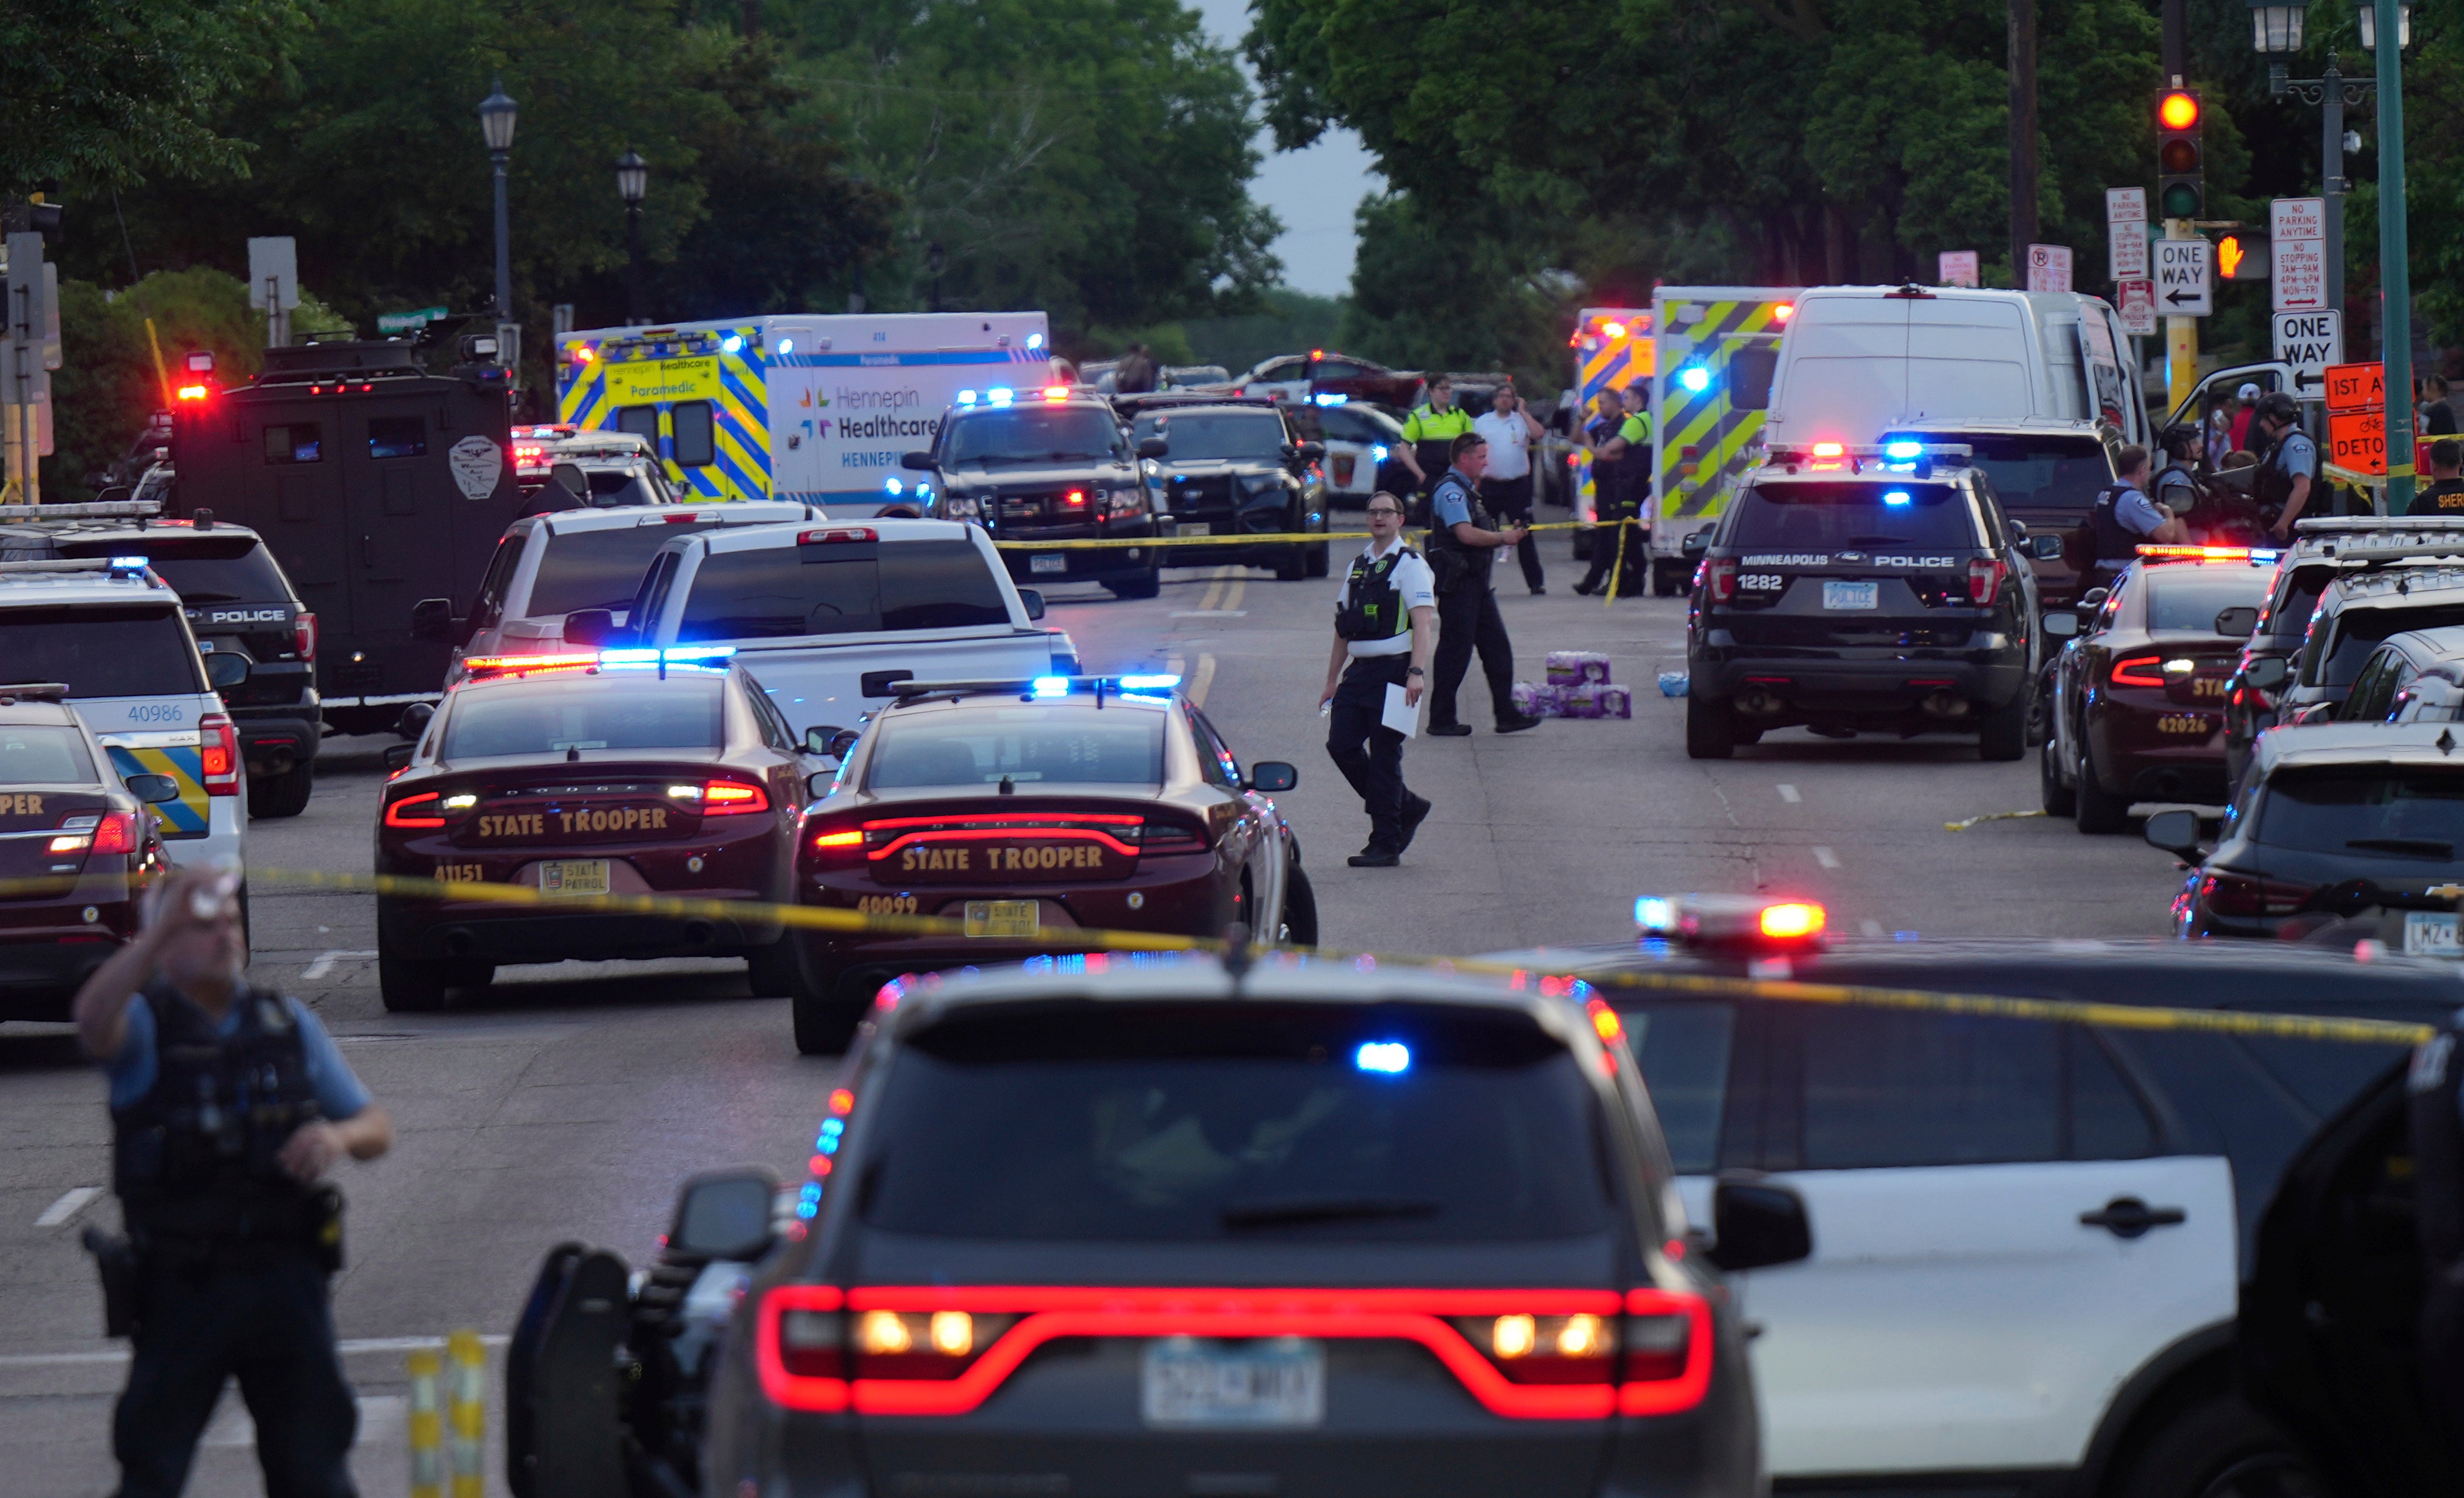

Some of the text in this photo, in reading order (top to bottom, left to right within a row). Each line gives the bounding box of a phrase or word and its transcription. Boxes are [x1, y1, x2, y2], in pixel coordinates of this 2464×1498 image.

[2279, 216, 2317, 225] PARKING
[2280, 226, 2317, 236] ANYTIME
[2164, 247, 2202, 263] ONE
[2293, 243, 2304, 252] NO
[2280, 253, 2319, 263] STOPPING
[2162, 267, 2202, 284] WAY
[2284, 317, 2331, 338] ONE
[873, 332, 886, 342] 414
[2283, 343, 2331, 364] WAY
[660, 359, 710, 371] Healthcare
[631, 381, 696, 397] Paramedic
[2334, 376, 2385, 395] 1ST A
[837, 386, 920, 412] Hennepin
[838, 414, 938, 439] Healthcare
[1741, 554, 1829, 566] MINNEAPOLIS
[1874, 556, 1955, 567] POLICE
[1737, 574, 1783, 590] 1282
[1828, 588, 1873, 604] POLICE
[212, 610, 286, 623] POLICE
[128, 705, 182, 722] 40986
[2157, 716, 2208, 733] 42026
[506, 784, 638, 796] DODGE
[0, 794, 44, 814] PER
[479, 807, 668, 838] STATE TROOPER
[902, 845, 1104, 871] STATE TROOPER
[434, 863, 483, 882] 41151
[566, 863, 599, 876] STATE
[564, 878, 605, 890] PATROL
[857, 895, 918, 915] 40099
